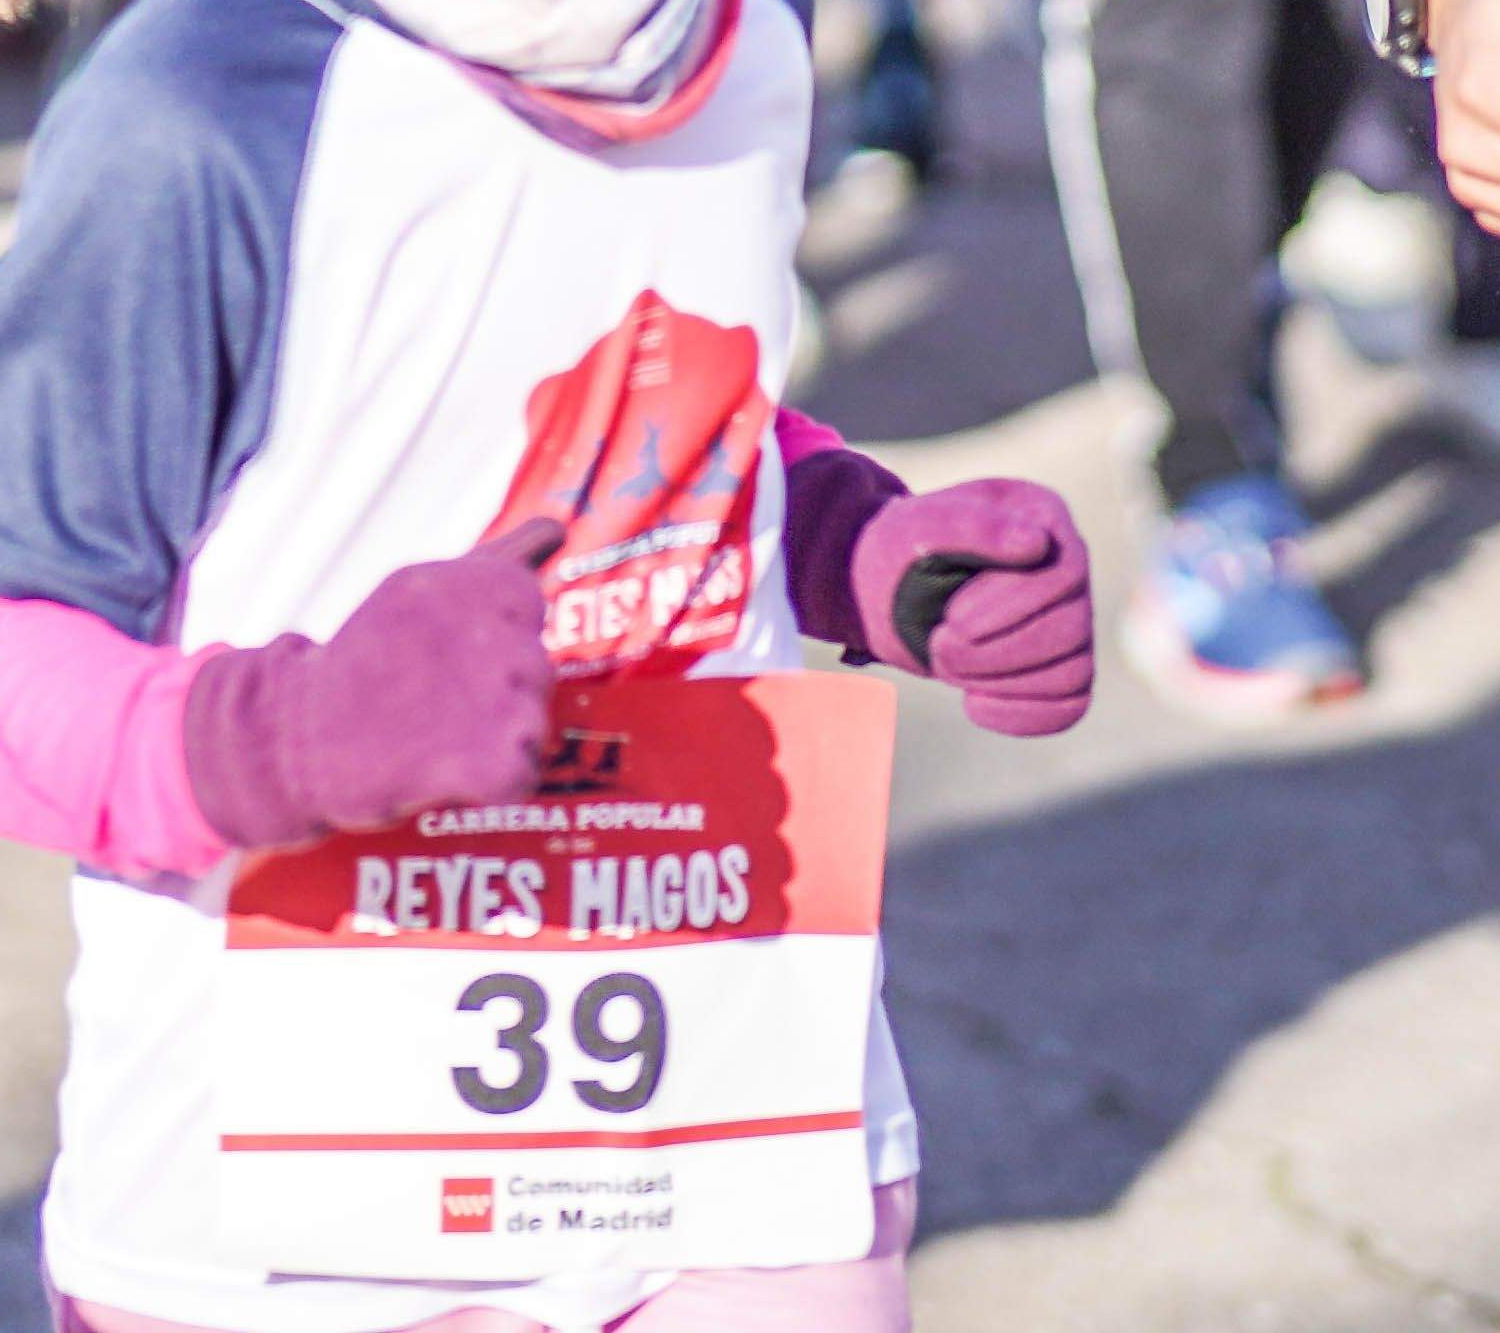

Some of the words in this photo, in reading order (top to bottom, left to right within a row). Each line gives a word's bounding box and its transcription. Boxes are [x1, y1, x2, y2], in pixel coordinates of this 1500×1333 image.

[418, 805, 570, 837] CARRERA
[576, 802, 705, 832] POPULAR
[352, 854, 546, 938] REYES
[569, 844, 750, 940] MAGOS
[451, 973, 668, 1116] 39
[507, 1170, 672, 1196] Comunidad
[507, 1211, 543, 1232] de
[558, 1205, 672, 1230] Madrid
